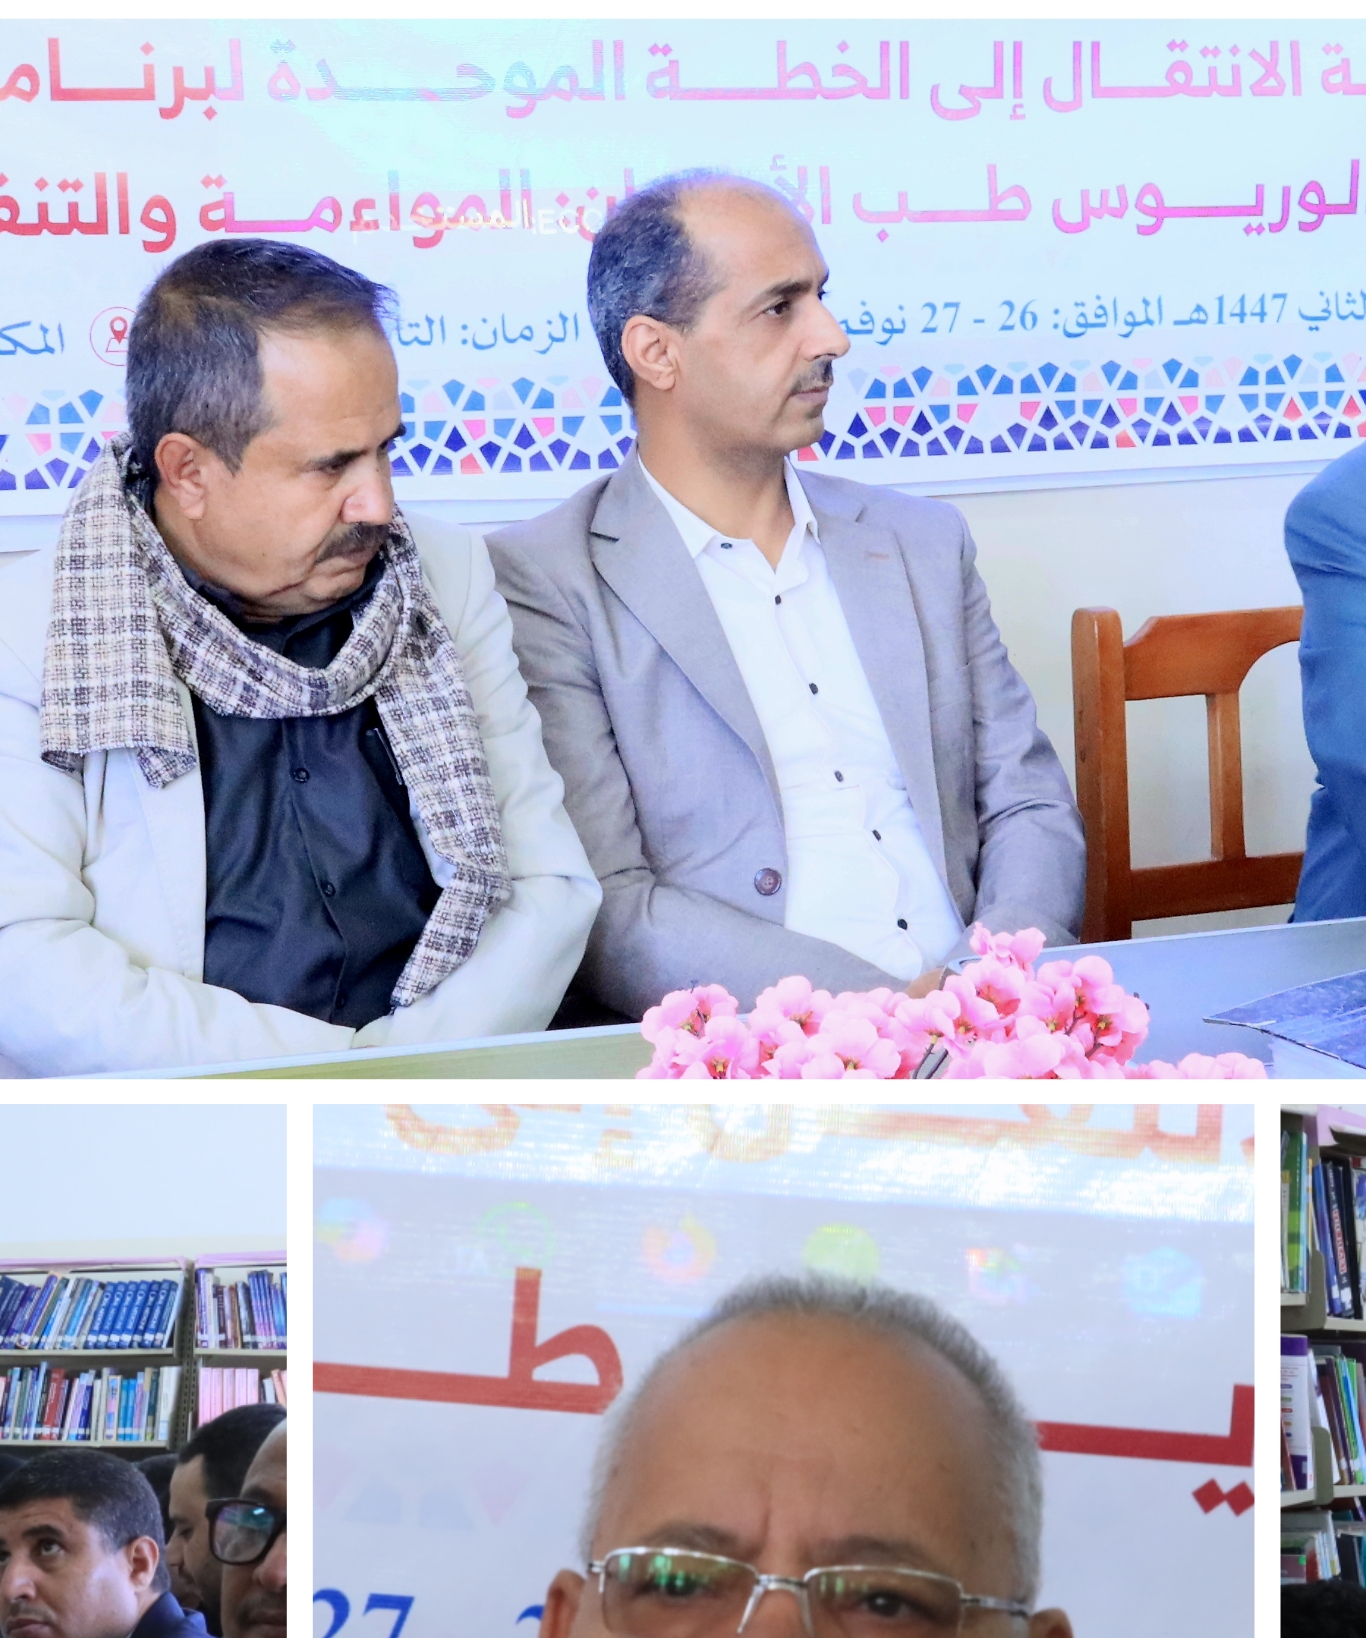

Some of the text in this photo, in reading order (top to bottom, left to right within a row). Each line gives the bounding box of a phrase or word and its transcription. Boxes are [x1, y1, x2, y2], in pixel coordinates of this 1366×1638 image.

[267, 38, 625, 119] الموحدة
[645, 39, 909, 102] الخطة
[929, 40, 1023, 120] إلى
[1043, 38, 1301, 114] الانتقال
[852, 164, 1032, 242] طب
[461, 310, 579, 355] الزمان:
[919, 301, 962, 335] 27
[997, 299, 1039, 334] 26
[1051, 295, 1164, 340] الموافق:
